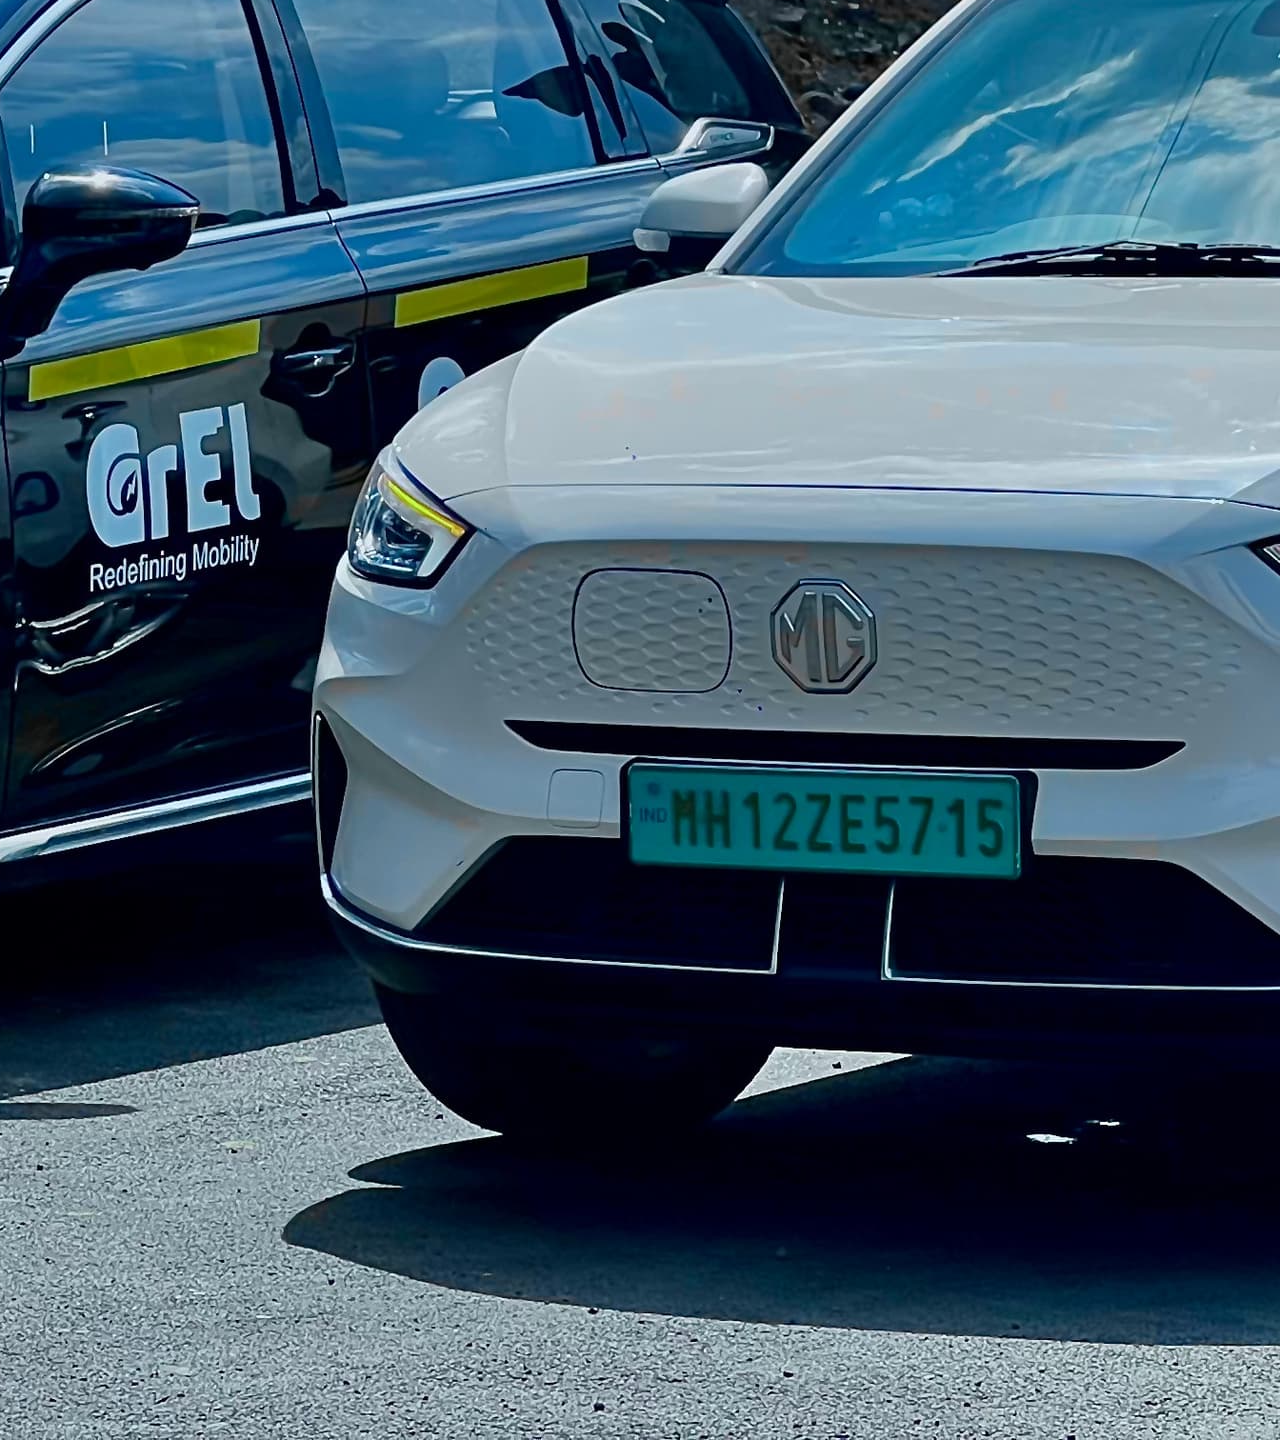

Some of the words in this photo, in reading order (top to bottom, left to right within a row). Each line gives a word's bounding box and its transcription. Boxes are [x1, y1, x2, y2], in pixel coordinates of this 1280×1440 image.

[90, 550, 187, 592] Redefining
[193, 534, 260, 571] Mobility
[780, 592, 865, 683] MG
[640, 807, 667, 824] IND
[671, 789, 1005, 859] MH12ZE5715
